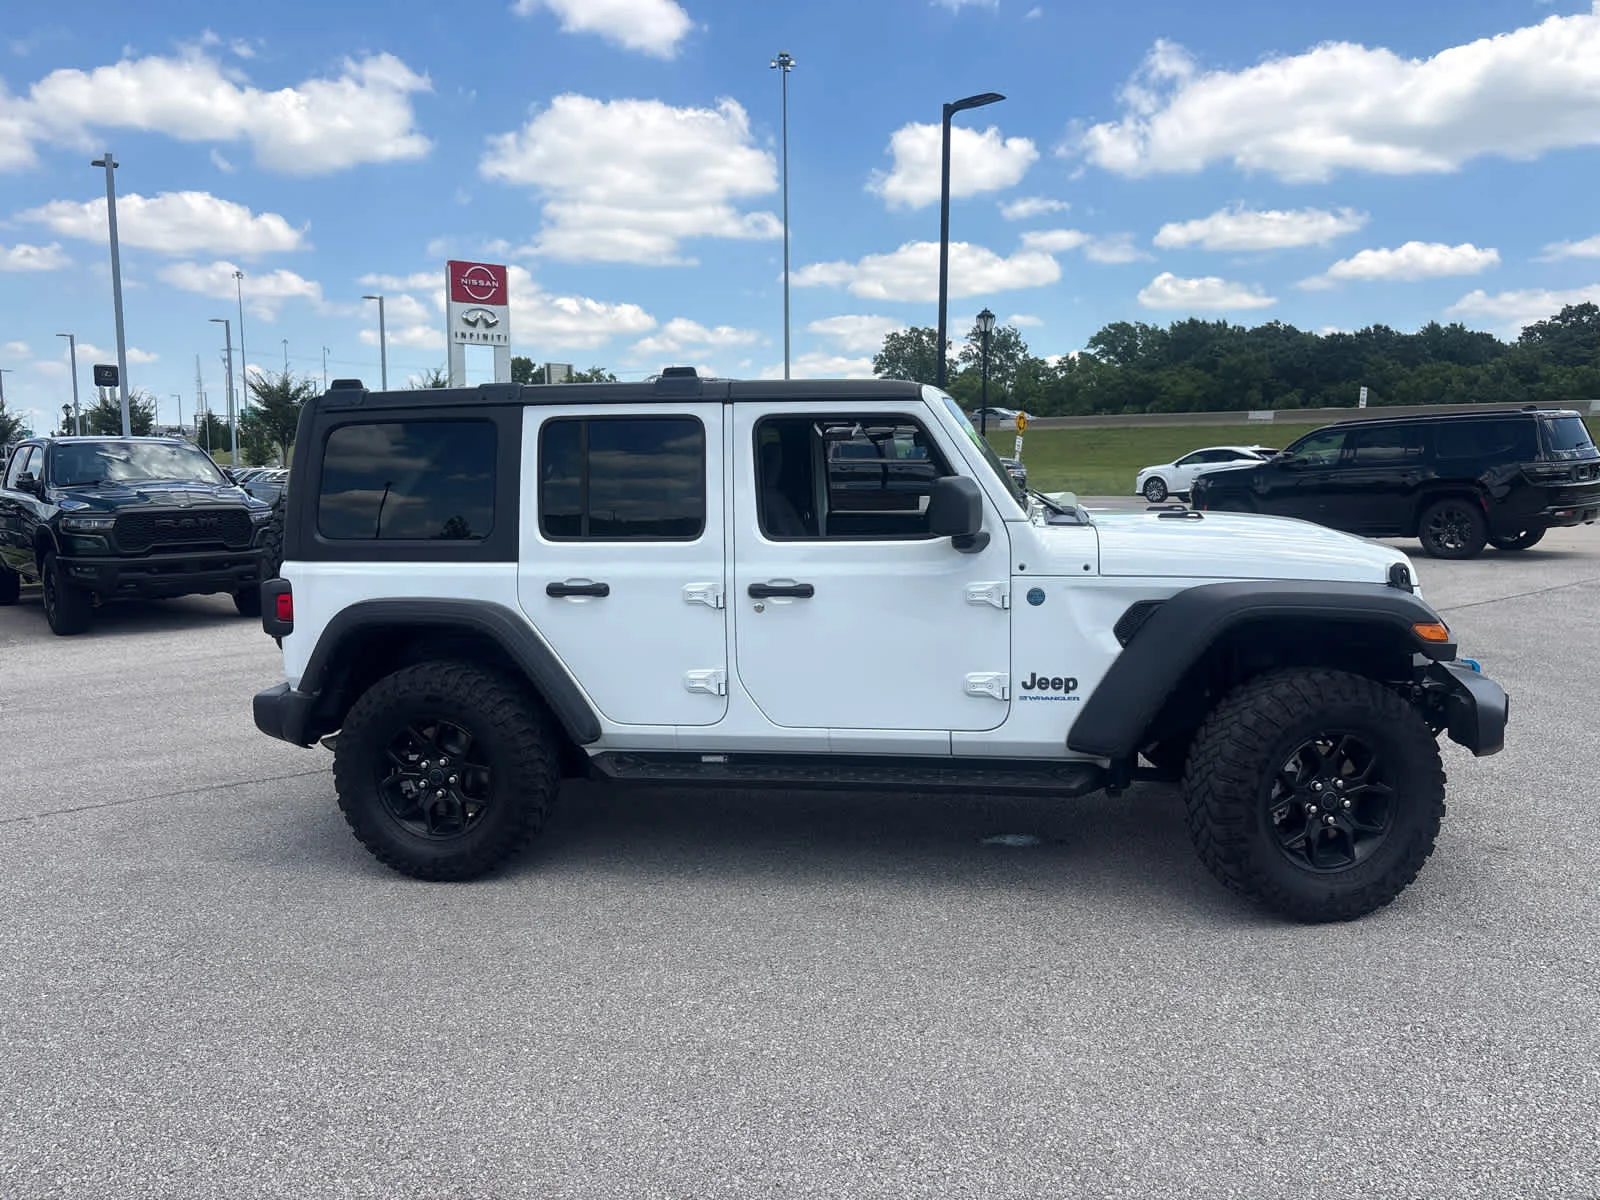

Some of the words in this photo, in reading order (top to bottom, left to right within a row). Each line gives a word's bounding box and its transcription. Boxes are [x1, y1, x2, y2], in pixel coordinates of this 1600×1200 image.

[461, 278, 499, 288] NISSAN
[455, 331, 507, 342] INFINITI
[1021, 672, 1078, 694] Jeep
